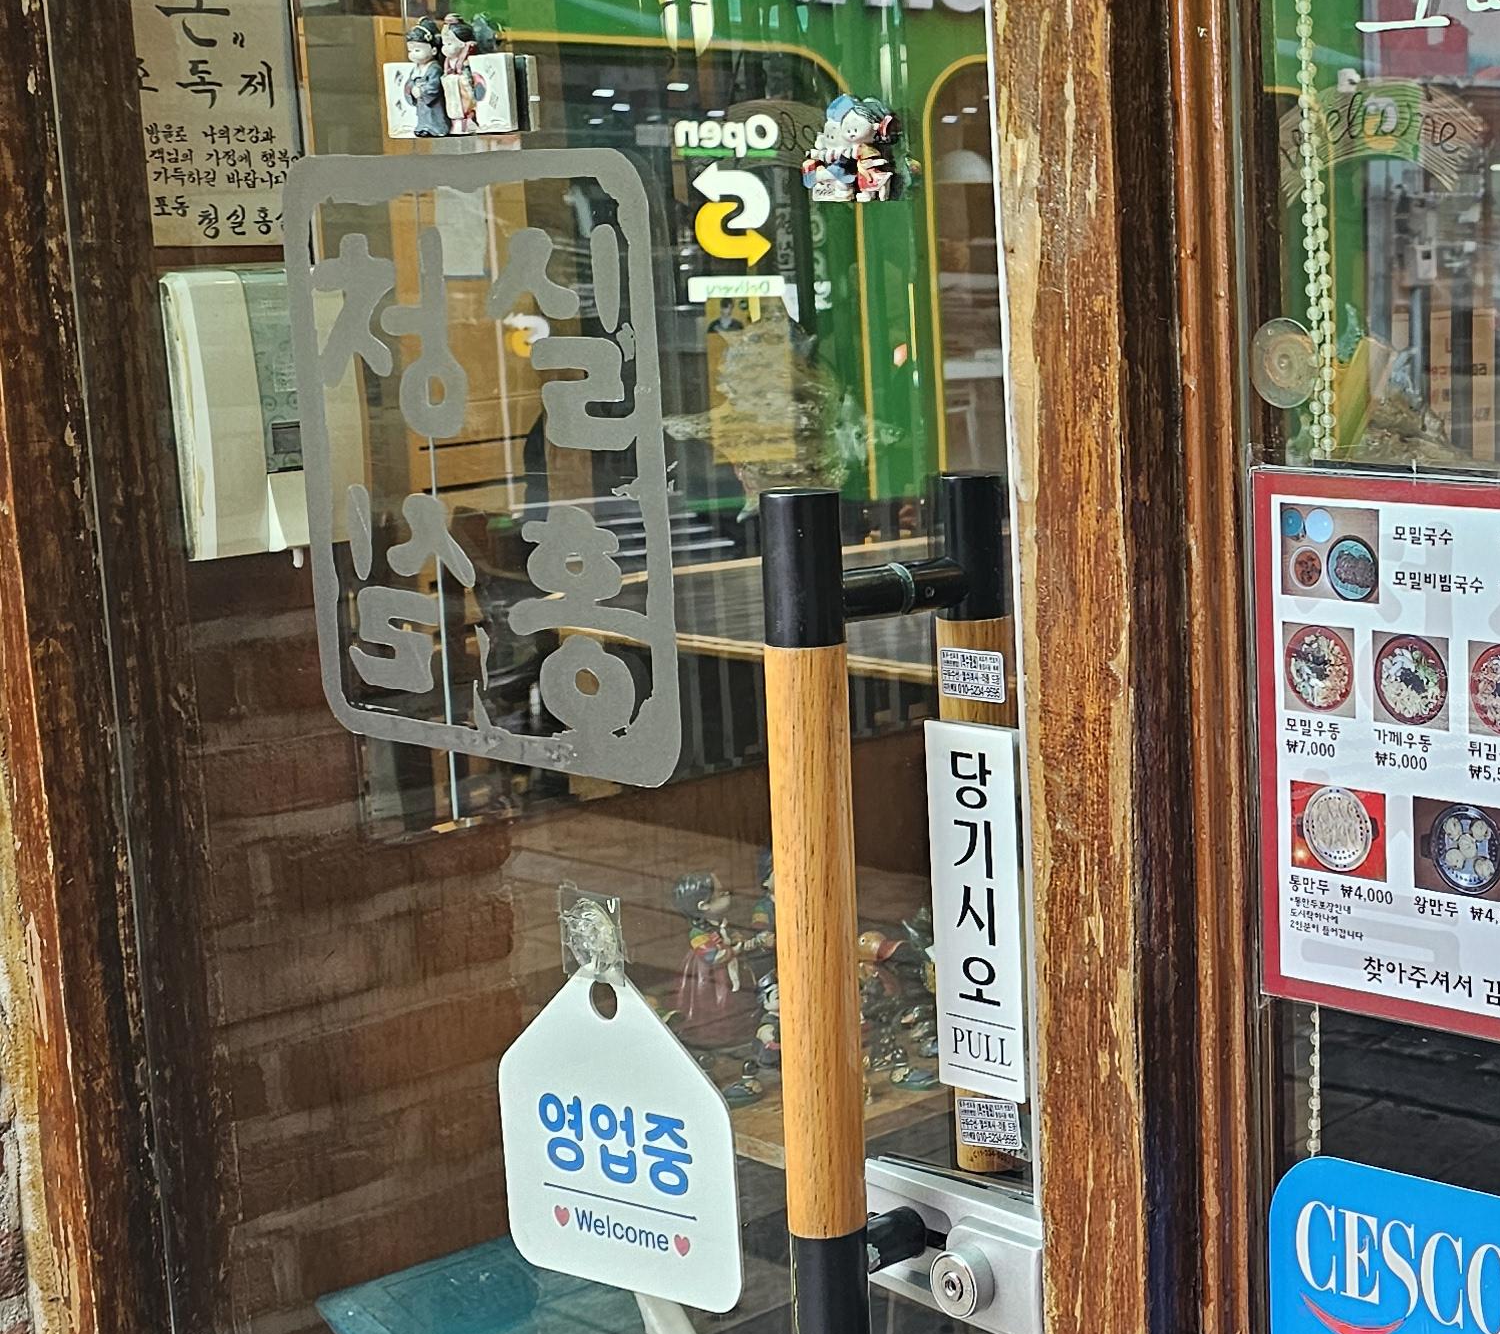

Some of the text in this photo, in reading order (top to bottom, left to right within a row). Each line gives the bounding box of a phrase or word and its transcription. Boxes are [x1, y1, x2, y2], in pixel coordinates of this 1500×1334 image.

[146, 147, 194, 165] 객님의
[205, 149, 252, 168] 가정에
[153, 167, 216, 187] 가득하길
[153, 195, 190, 217] 포동
[198, 203, 285, 239] 청실홍
[1392, 526, 1454, 547] 모밀국수
[1392, 571, 1485, 593] 모밀비빔국수
[1284, 717, 1341, 741] 모밀우동
[1373, 728, 1433, 753] 가께우동
[1285, 739, 1336, 758] ₩7,000
[1374, 751, 1428, 771] ₩5,000
[950, 749, 1003, 1008] 당기시오
[1289, 875, 1394, 905] 통만두 ₩4,000
[1413, 895, 1459, 917] 왕만두
[1363, 955, 1474, 998] 찾아주셔서
[952, 1025, 1014, 1070] PULL
[537, 1091, 694, 1196] 영업중
[575, 1205, 670, 1253] Welcome
